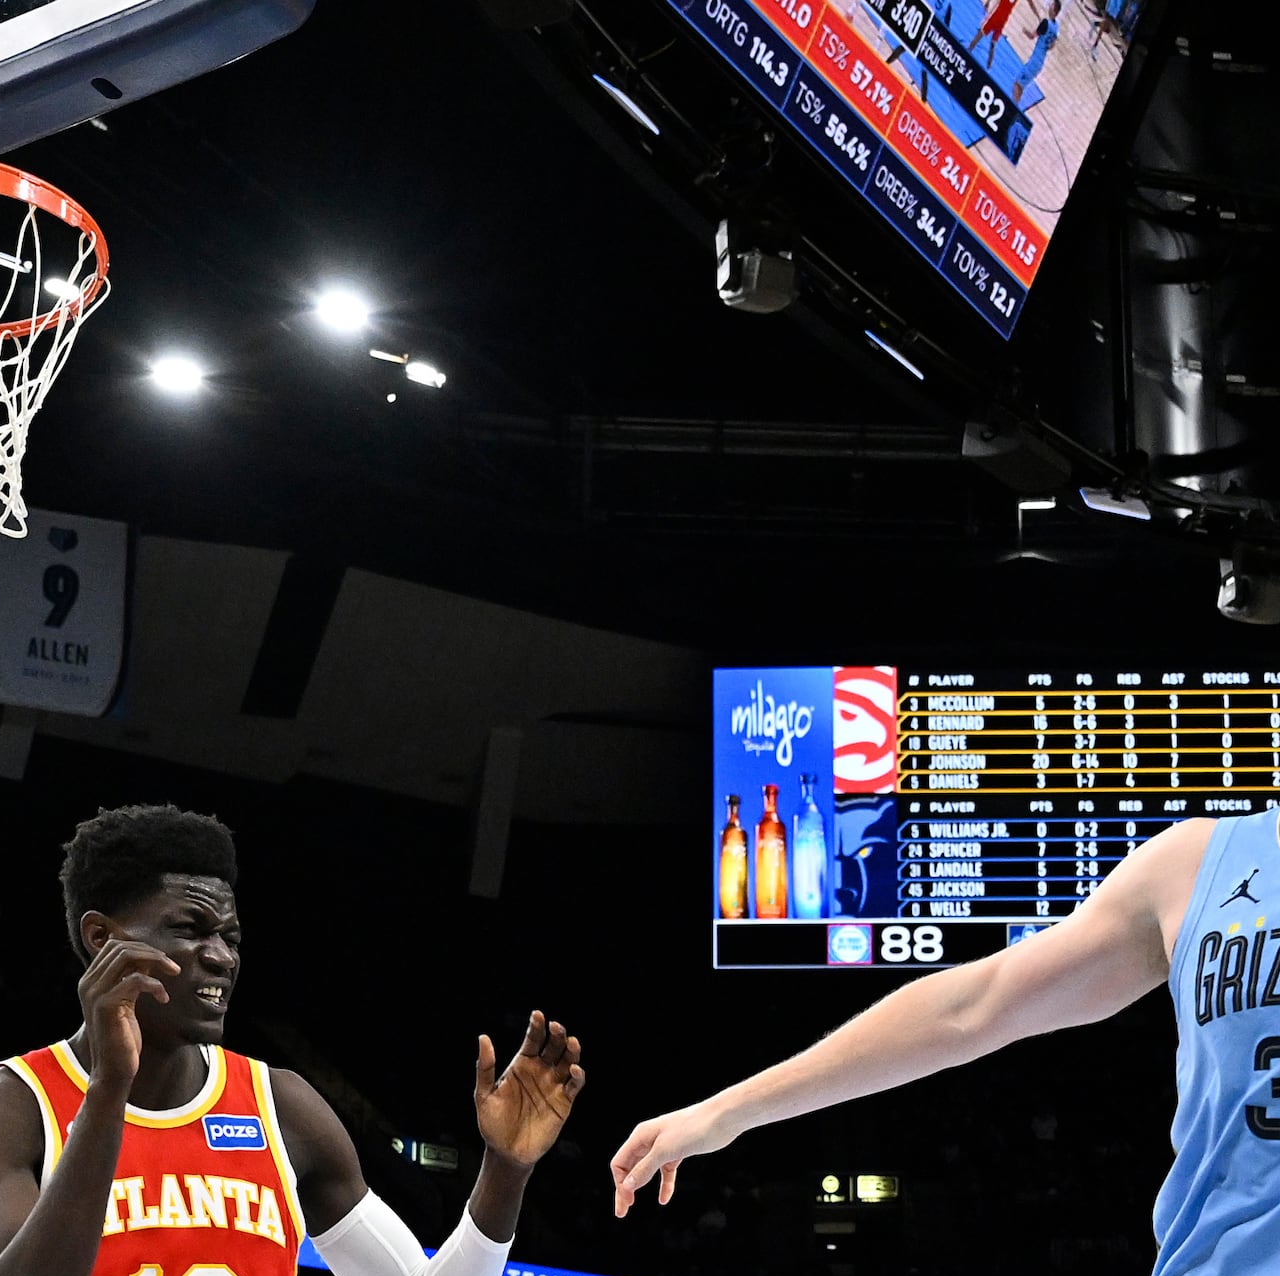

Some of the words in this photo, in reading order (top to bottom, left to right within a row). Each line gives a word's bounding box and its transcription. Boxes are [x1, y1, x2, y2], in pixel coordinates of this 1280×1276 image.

[920, 41, 947, 78] FOULS:
[928, 25, 967, 77] TIMEOUTS:
[976, 85, 1006, 132] 82
[819, 24, 850, 70] TS%
[850, 60, 894, 116] 57.1%
[898, 111, 942, 166] OREB%
[940, 156, 969, 195] 24.1
[973, 190, 1014, 240] TOV%
[1011, 230, 1038, 266] 11.5
[706, 0, 748, 47] ORTG
[750, 37, 789, 86] 114.3
[796, 81, 825, 124] TS%
[825, 114, 871, 171] 56.4%
[875, 165, 918, 219] OREB%
[916, 208, 946, 247] 34.4
[952, 243, 992, 292] TOV%
[990, 282, 1016, 318] 12.1
[42, 564, 80, 629] 9
[27, 636, 90, 667] ALLEN
[928, 674, 974, 686] PLAYER
[1028, 673, 1052, 686] PTS
[1161, 673, 1186, 685] AST
[1202, 672, 1250, 684] STOCKS
[928, 695, 995, 711] MCCOLLUM
[731, 679, 813, 767] milagro
[928, 715, 984, 731] KENNARD
[1033, 715, 1048, 730] 16
[928, 735, 967, 750] GUEYE
[1035, 734, 1045, 749] 7
[928, 754, 987, 770] JOHNSON
[1032, 753, 1050, 769] 20
[928, 774, 979, 790] DANIELS
[1036, 773, 1046, 789] 3
[929, 801, 975, 813] PLAYER
[1030, 801, 1054, 813] PTS
[1163, 799, 1187, 811] AST
[1204, 799, 1252, 811] STOCKS
[929, 822, 989, 838] WILLIAMS
[991, 822, 1010, 838] JR.
[1036, 822, 1048, 838] 0
[1075, 821, 1098, 838] 0-2
[1125, 821, 1137, 837] 0
[929, 843, 981, 858] SPENCER
[1037, 842, 1046, 858] 7
[929, 863, 983, 877] LANDALE
[930, 882, 985, 897] JACKSON
[1037, 882, 1048, 897] 9
[930, 902, 971, 917] WELLS
[1036, 901, 1050, 916] 12
[880, 925, 944, 962] 88
[210, 1122, 258, 1140] paze
[102, 1174, 287, 1248] TLANTA
